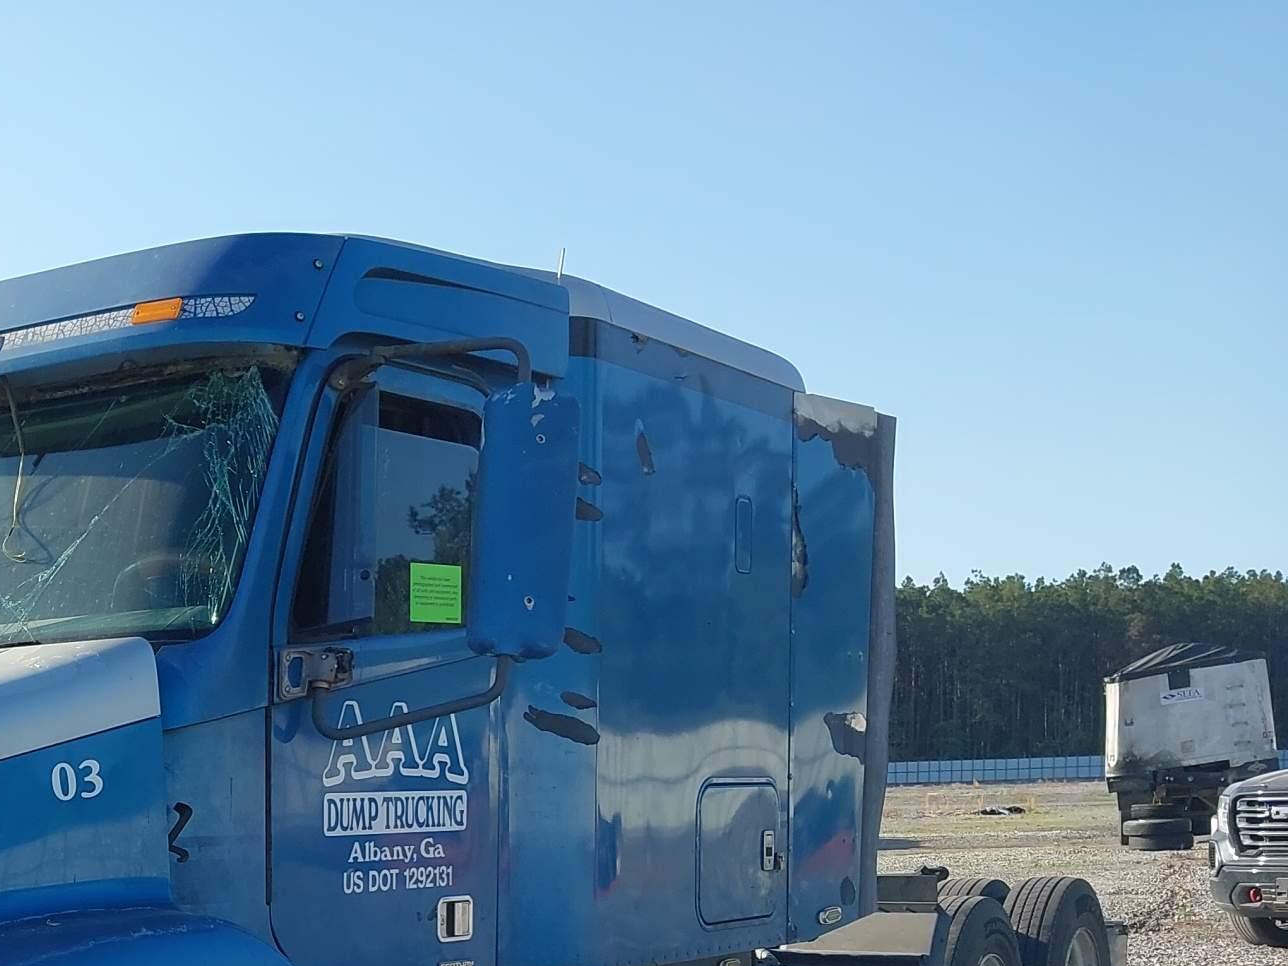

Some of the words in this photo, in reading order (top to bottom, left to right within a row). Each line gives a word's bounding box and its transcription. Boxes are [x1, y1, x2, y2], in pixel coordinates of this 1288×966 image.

[323, 701, 469, 787] AAA
[52, 760, 103, 801] 03
[327, 797, 379, 832] DUMP
[382, 795, 465, 830] TRUCKING
[348, 840, 417, 863] Albany,
[420, 837, 445, 858] Ga
[343, 870, 364, 894] US
[369, 868, 399, 892] DOT
[404, 865, 453, 889] 1292131
